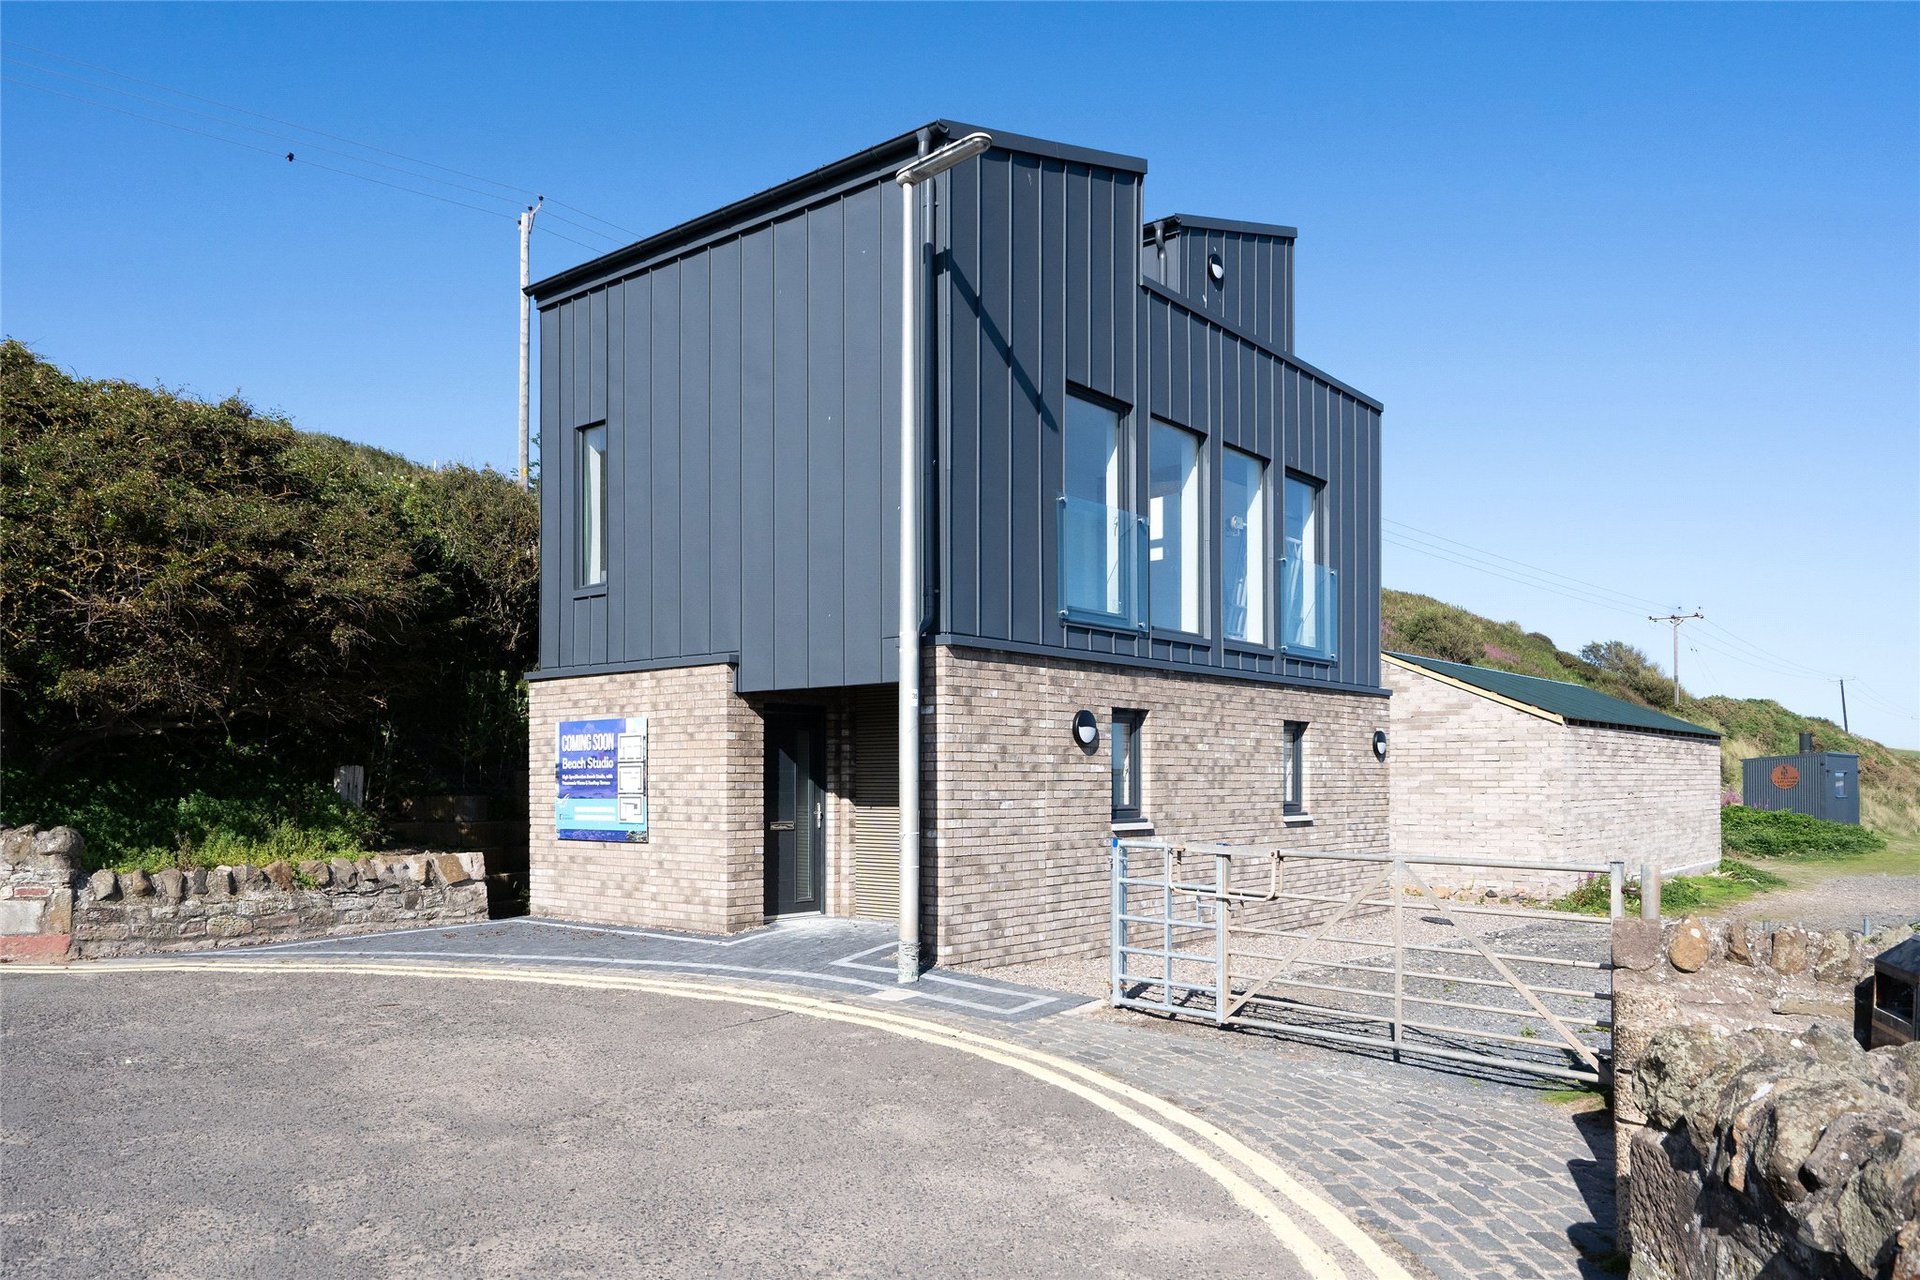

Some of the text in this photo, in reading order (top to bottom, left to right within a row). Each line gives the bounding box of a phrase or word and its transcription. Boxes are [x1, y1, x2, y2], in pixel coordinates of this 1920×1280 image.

[562, 733, 614, 751] COMING SOON
[562, 756, 613, 769] Beach Studio
